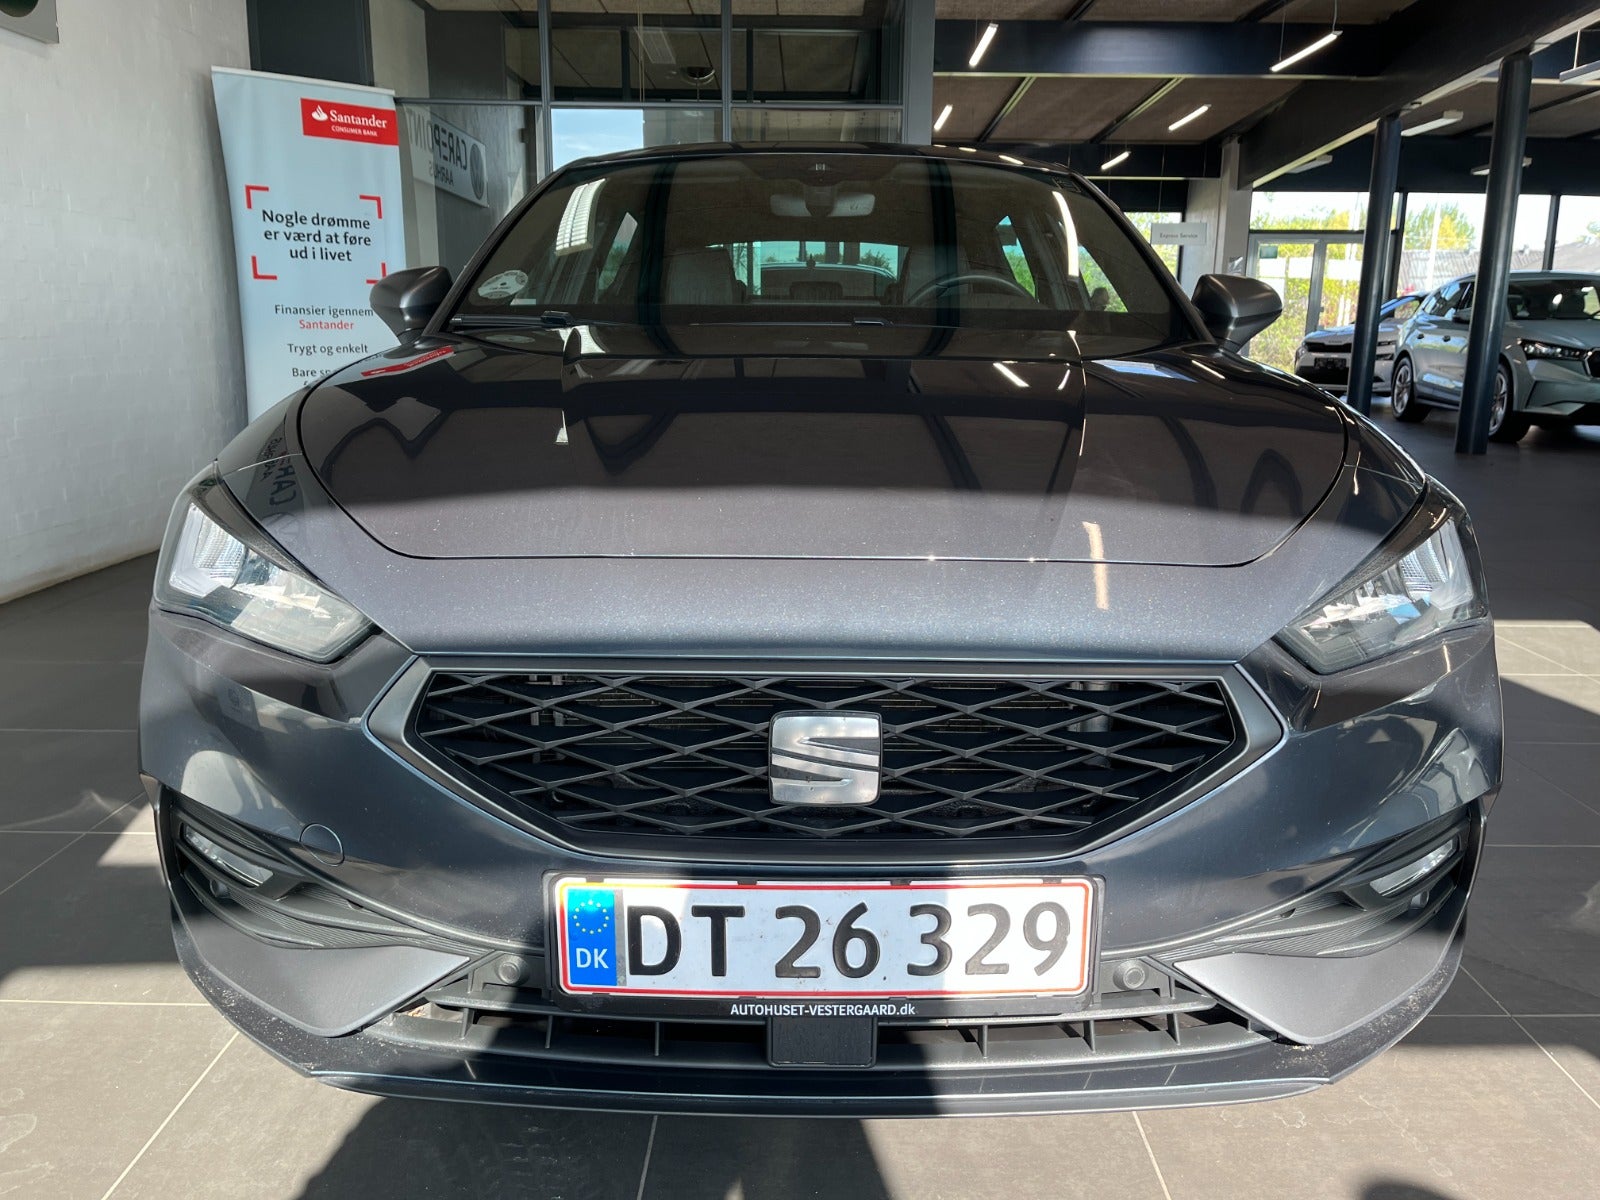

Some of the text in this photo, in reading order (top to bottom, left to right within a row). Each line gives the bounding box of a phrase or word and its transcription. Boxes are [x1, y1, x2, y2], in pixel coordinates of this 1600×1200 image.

[329, 109, 388, 128] Santander
[331, 125, 378, 137] CONSUMER BANK
[262, 209, 371, 229] Nogle drømme
[264, 229, 372, 246] er værd at føre
[289, 246, 352, 261] ud i livet
[274, 304, 374, 319] Finansier igennem
[299, 319, 354, 330] Santander
[287, 343, 369, 357] Trygt og enkelt
[292, 367, 317, 377] Bare
[626, 901, 1072, 979] DT 26 329
[575, 946, 609, 970] DK
[729, 1003, 917, 1017] AUTOHUSET-VESTERGAARD.dk
